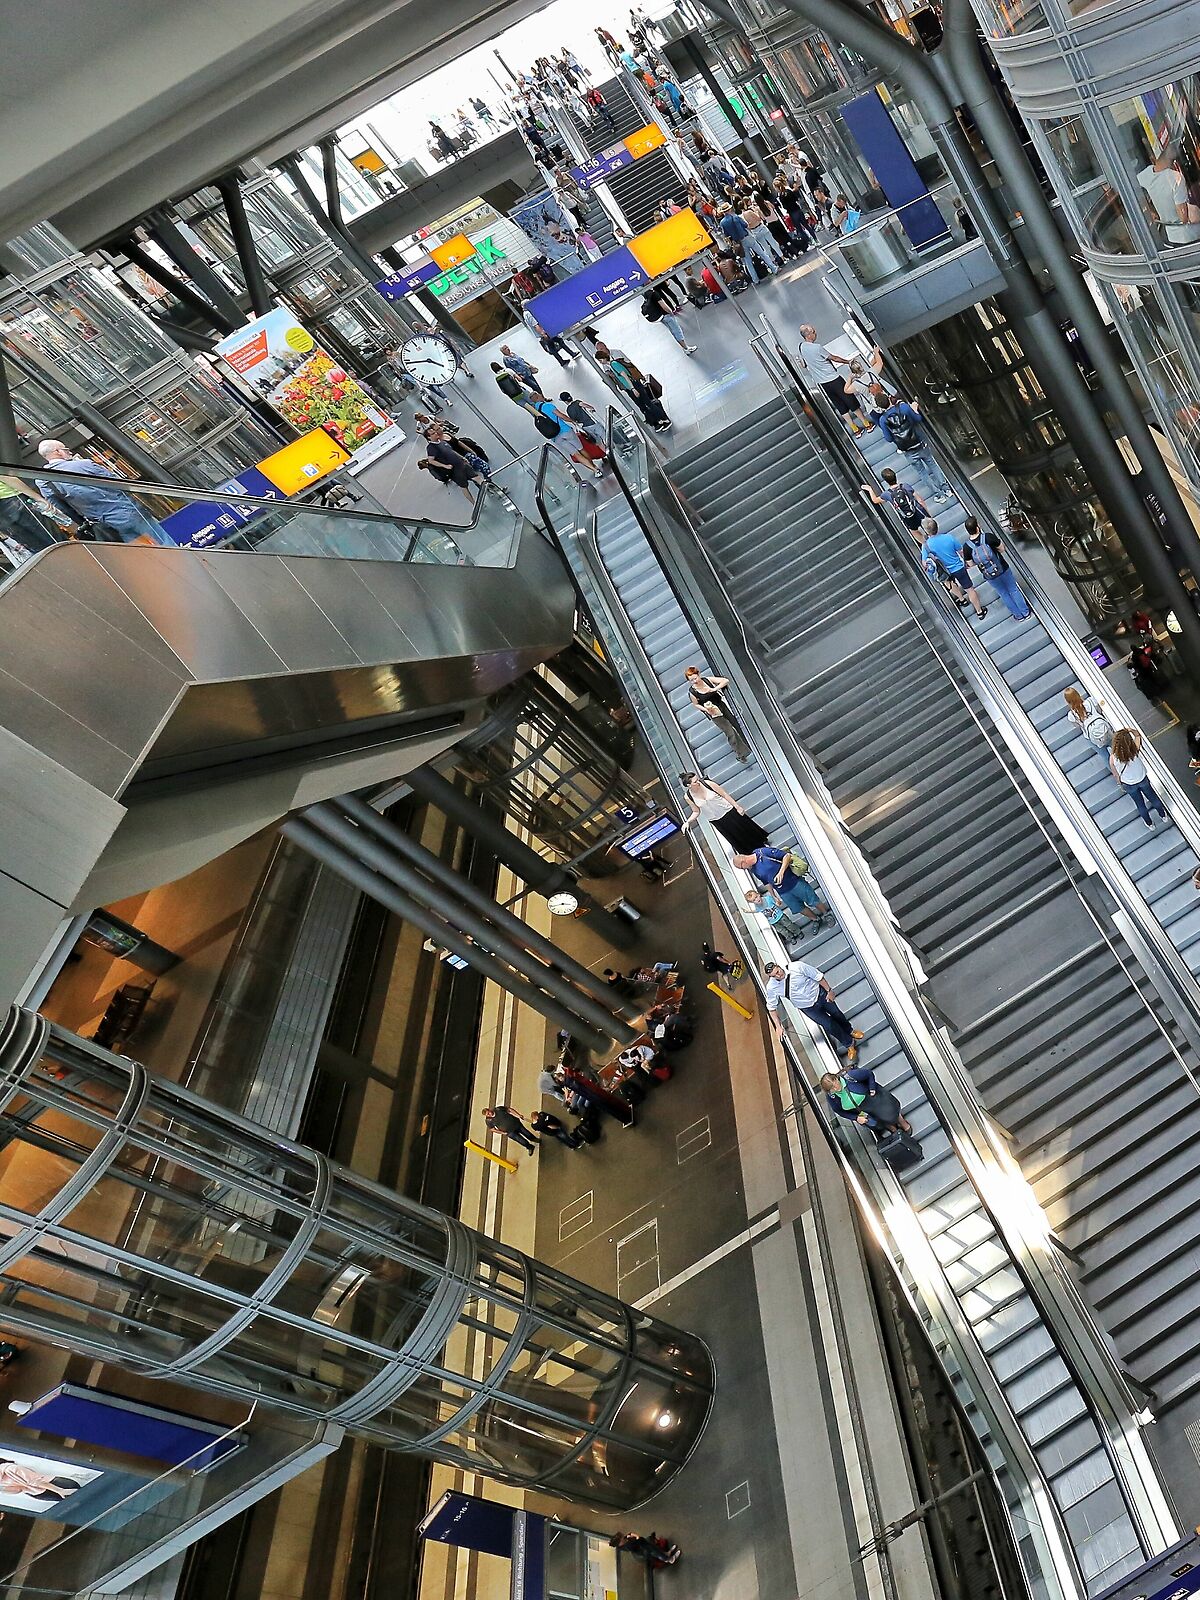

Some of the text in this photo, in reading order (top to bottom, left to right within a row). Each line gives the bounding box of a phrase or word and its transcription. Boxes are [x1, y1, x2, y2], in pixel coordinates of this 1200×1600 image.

[580, 157, 600, 173] 11-16
[385, 274, 400, 287] 1-8
[441, 261, 515, 306] VERSICHERNGEN
[602, 277, 626, 293] Ausgang
[620, 806, 634, 818] 5
